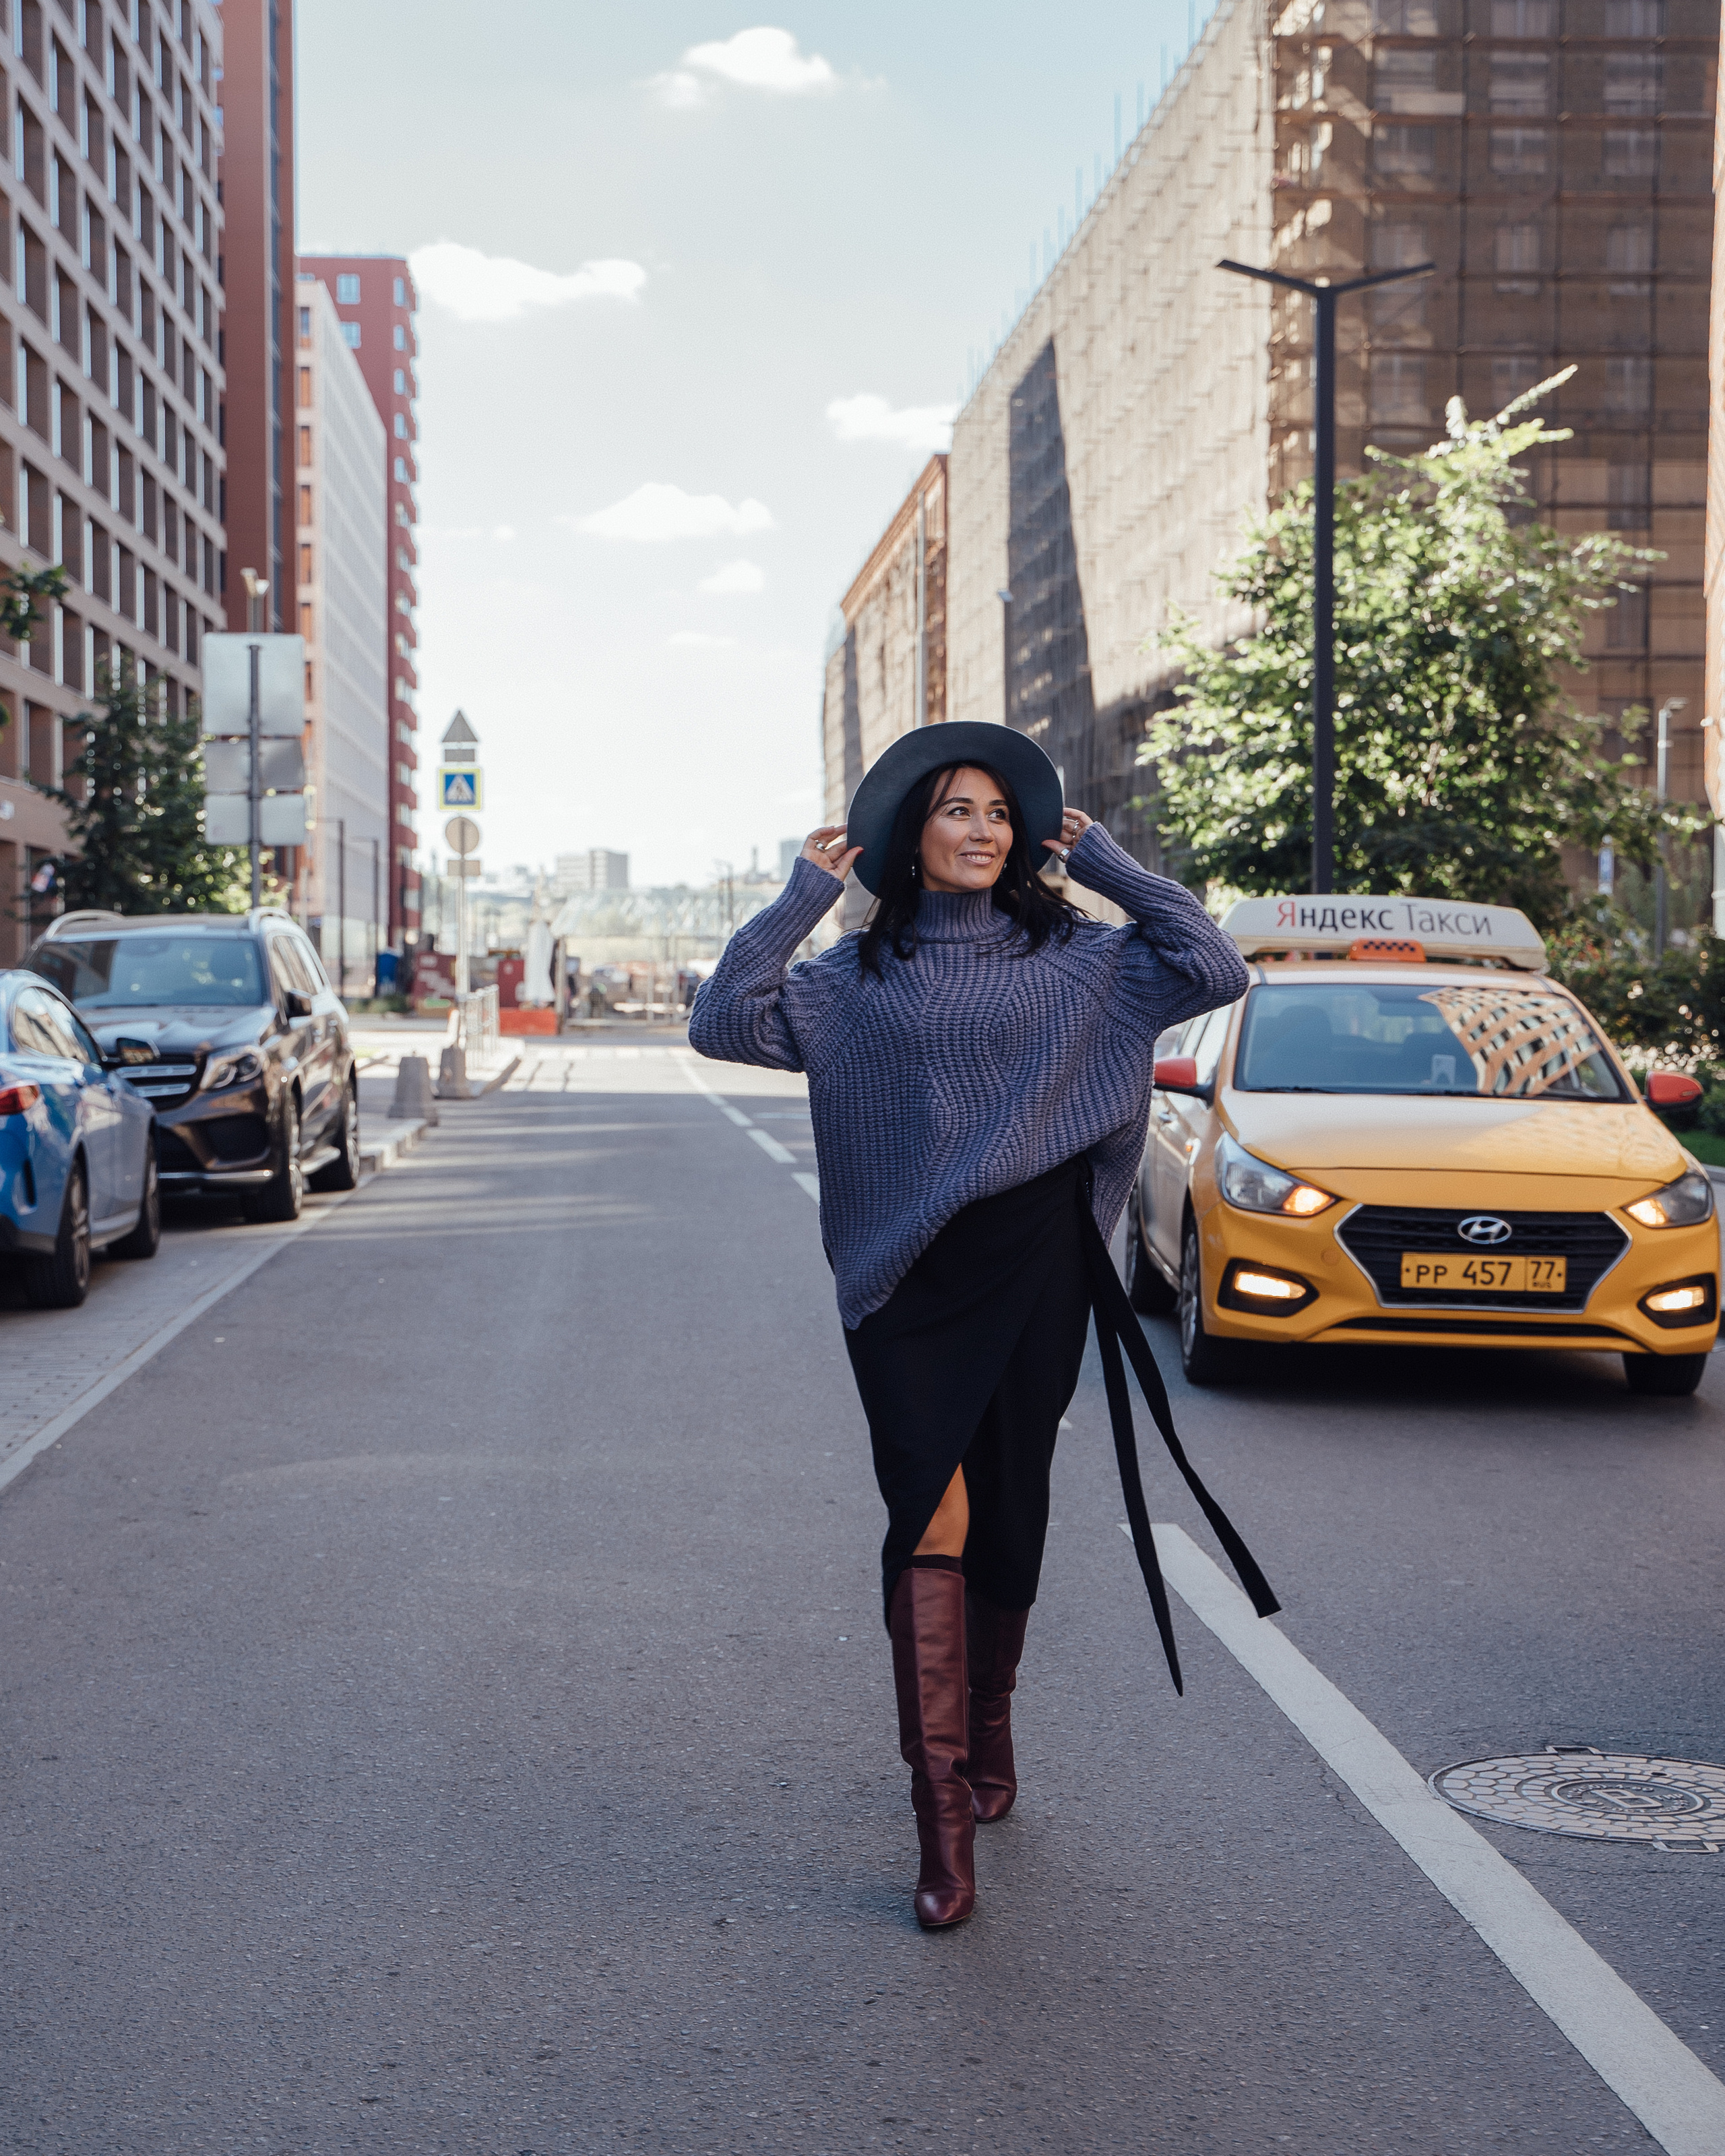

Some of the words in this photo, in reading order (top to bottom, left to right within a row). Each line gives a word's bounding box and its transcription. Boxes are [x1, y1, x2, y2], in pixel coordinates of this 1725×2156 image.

[1276, 900, 1394, 932] Яндекс
[1399, 902, 1492, 936] Такси
[1462, 1260, 1512, 1286] 457
[1530, 1260, 1555, 1279] 77
